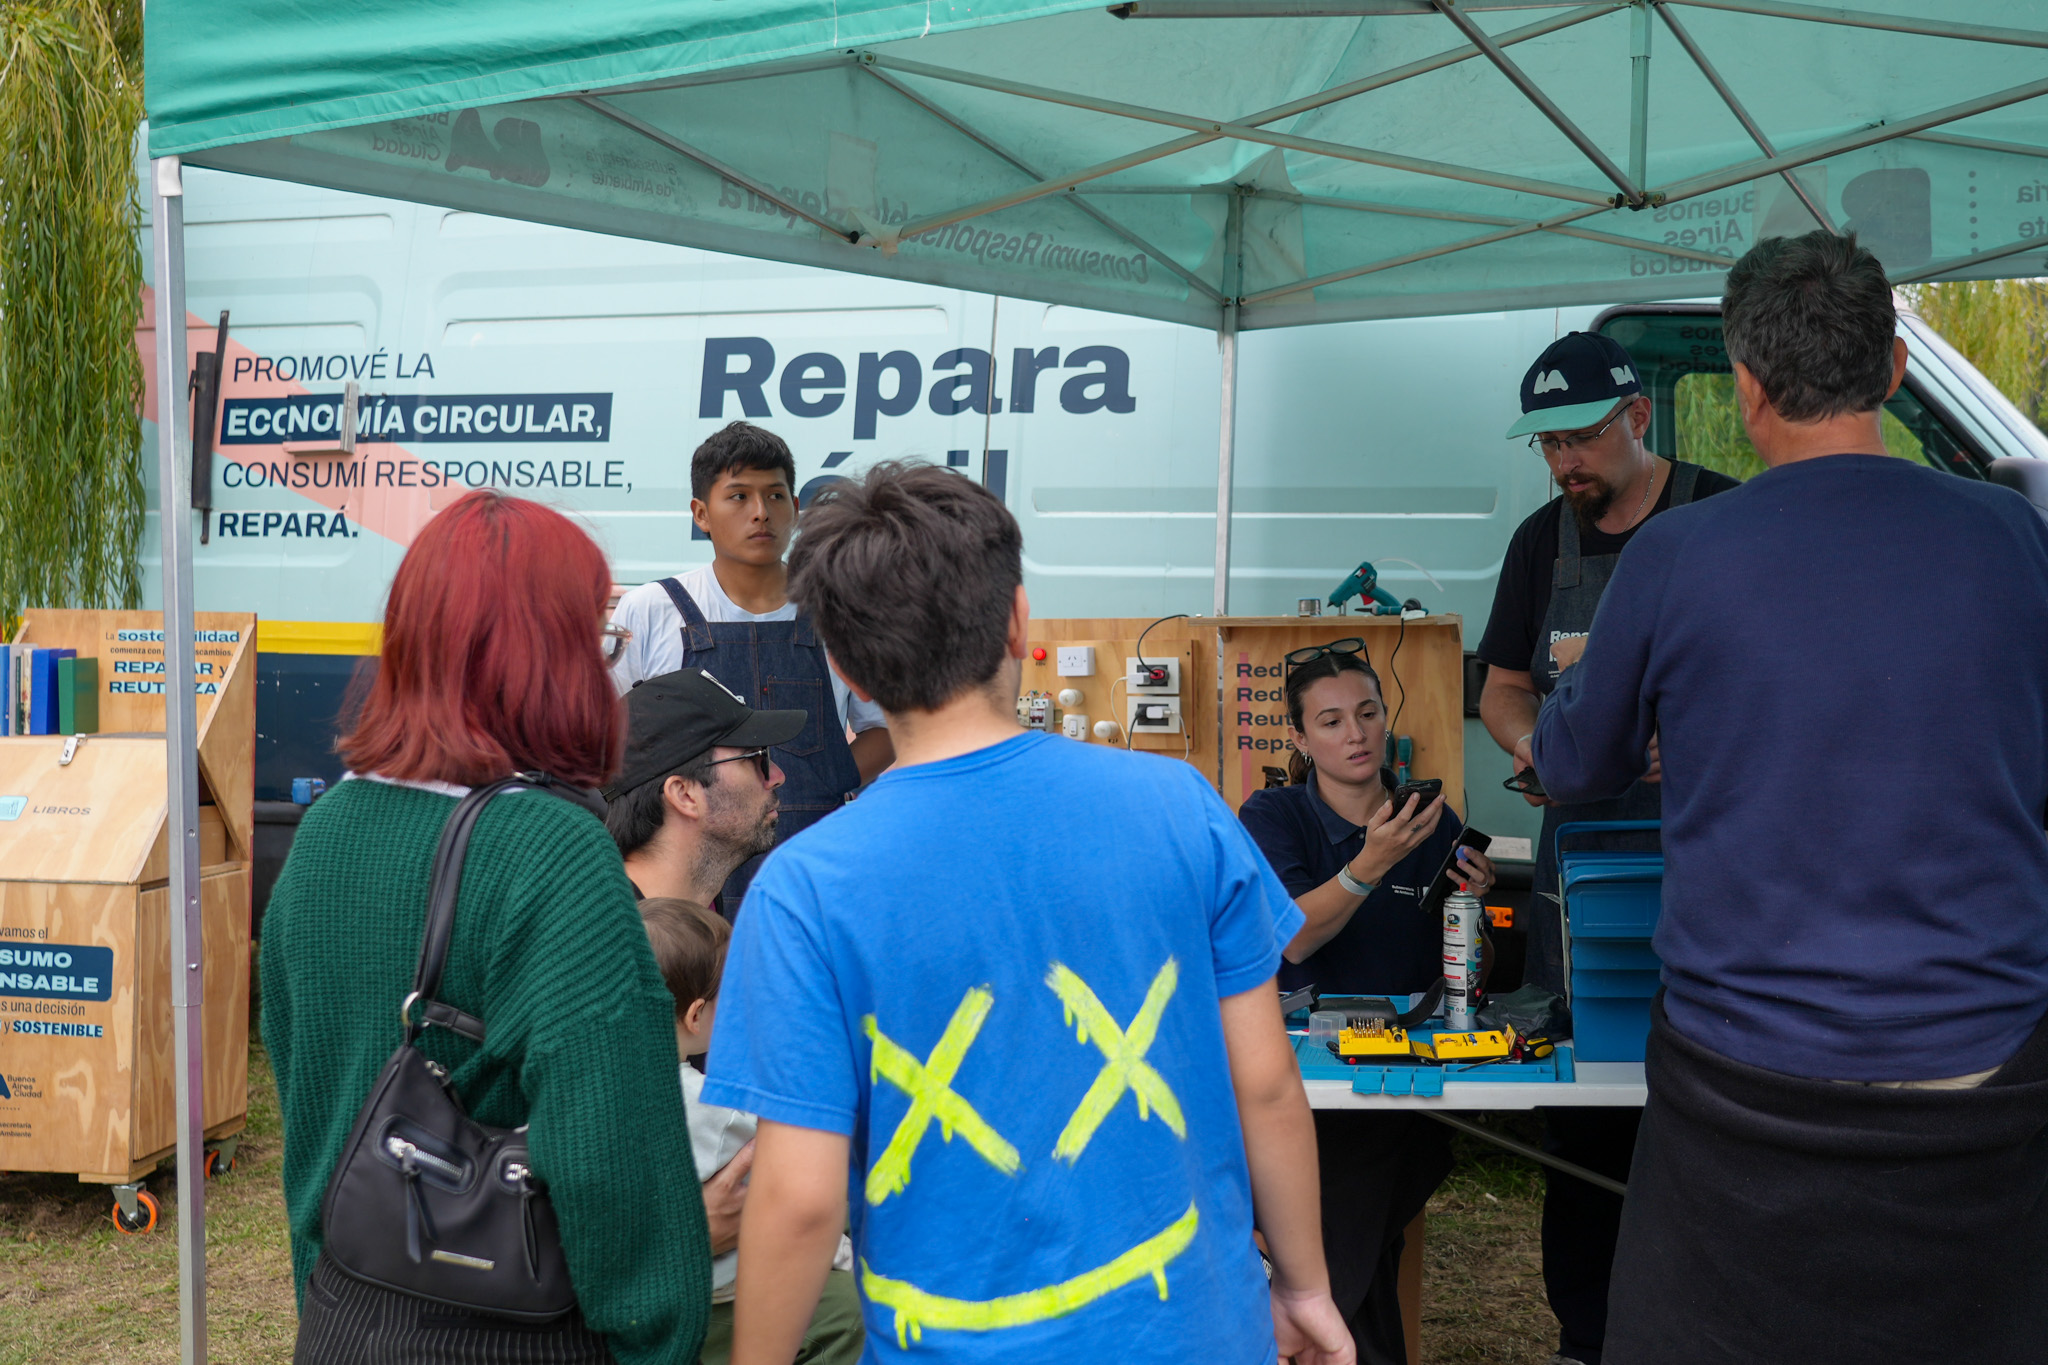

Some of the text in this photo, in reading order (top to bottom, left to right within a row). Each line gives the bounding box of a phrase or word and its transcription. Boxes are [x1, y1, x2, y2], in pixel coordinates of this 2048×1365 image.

[233, 347, 435, 382] PROMOVÉ LA
[699, 336, 1137, 440] Repara
[413, 403, 603, 438] CIRCULAR,
[223, 455, 633, 494] CONSUMÍ RESPONSABLE,
[219, 506, 359, 538] REPARÁ.
[106, 632, 115, 641] La
[110, 647, 146, 655] comienza
[147, 647, 161, 655] con
[33, 805, 91, 816] LIBROS
[38, 927, 48, 939] el
[10, 1002, 32, 1013] una
[35, 1001, 86, 1016] decisión
[13, 1020, 103, 1038] SOSTENIBLE
